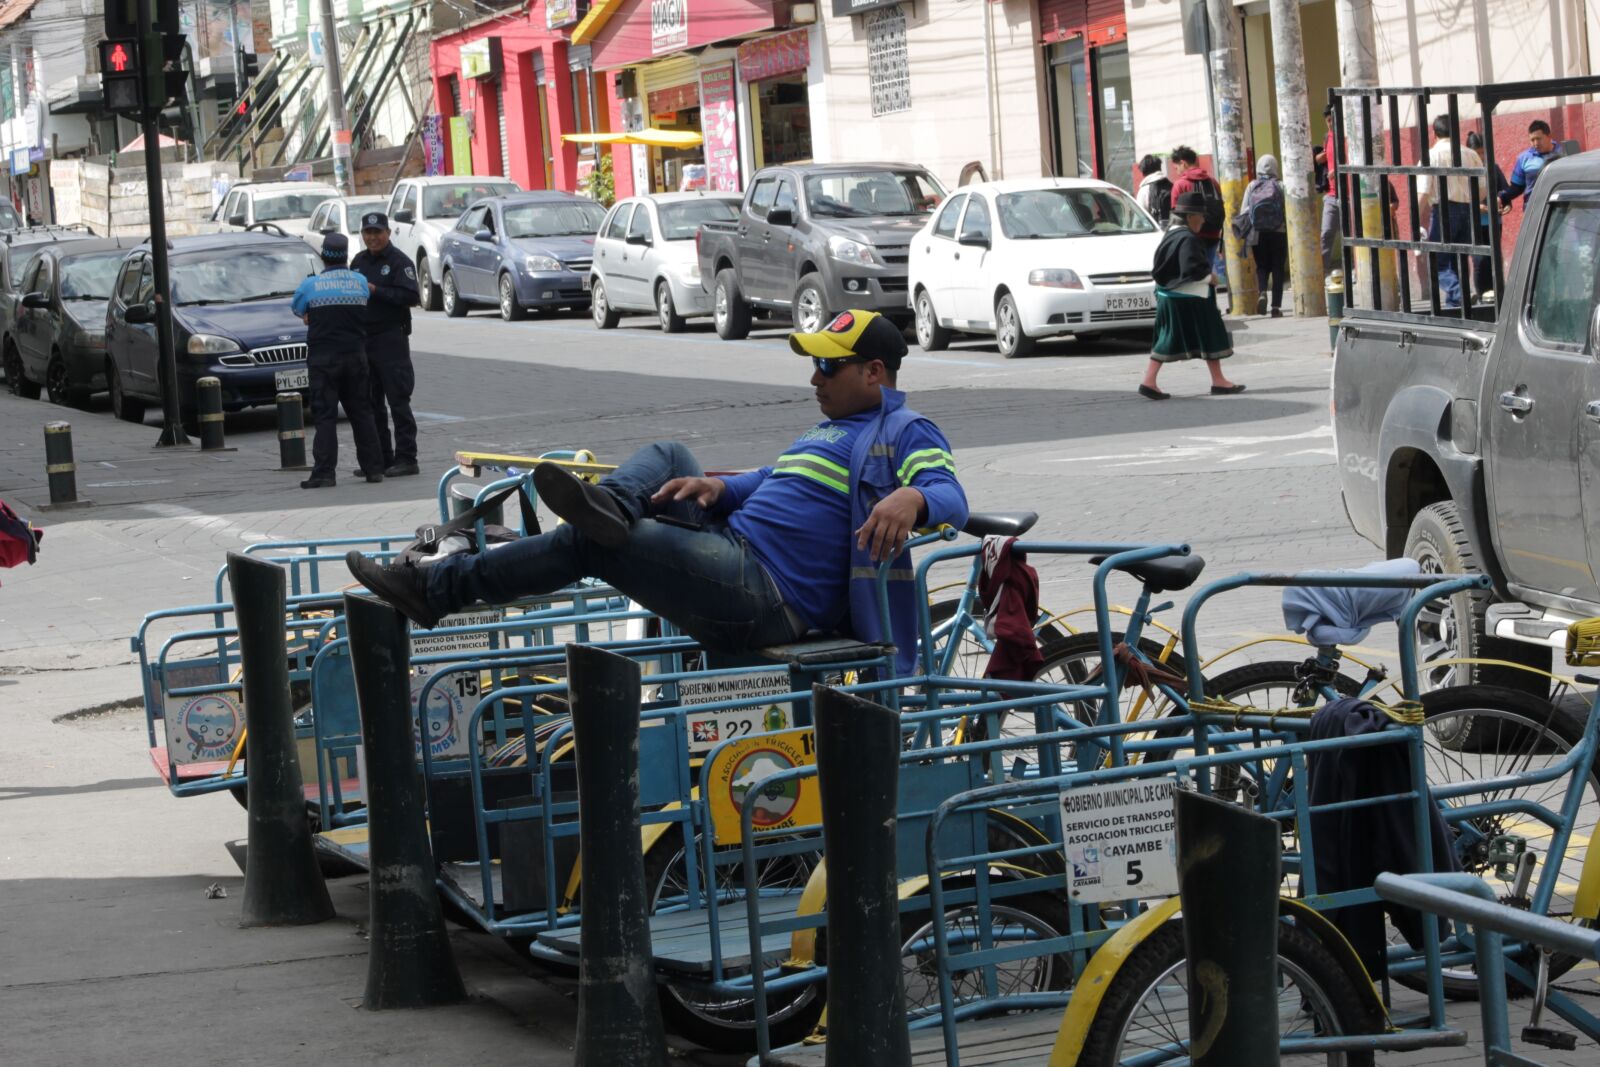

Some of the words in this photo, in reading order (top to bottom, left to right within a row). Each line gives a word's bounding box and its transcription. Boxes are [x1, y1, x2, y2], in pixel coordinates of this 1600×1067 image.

[314, 279, 365, 292] MUNICIPAL
[1106, 297, 1150, 309] PCR-7936
[276, 376, 309, 388] PYL-03
[413, 636, 444, 645] SERVICIO
[456, 633, 488, 641] TRANSPO
[415, 645, 457, 654] ASOCIACION
[455, 675, 478, 697] 15
[680, 684, 717, 697] GOBIERNO
[684, 695, 732, 705] ASOCIACION
[725, 719, 752, 740] 22
[1064, 793, 1102, 813] GOBIERNO
[1103, 786, 1142, 808] MUNICIPAL
[1144, 784, 1155, 803] DE
[1066, 818, 1110, 832] SERVICIO
[1112, 817, 1125, 826] DE
[1068, 832, 1127, 845] ASOCIACION
[1129, 822, 1174, 836] TRICICLER
[1103, 840, 1163, 858] CAYAMBE
[1126, 859, 1143, 886] 5
